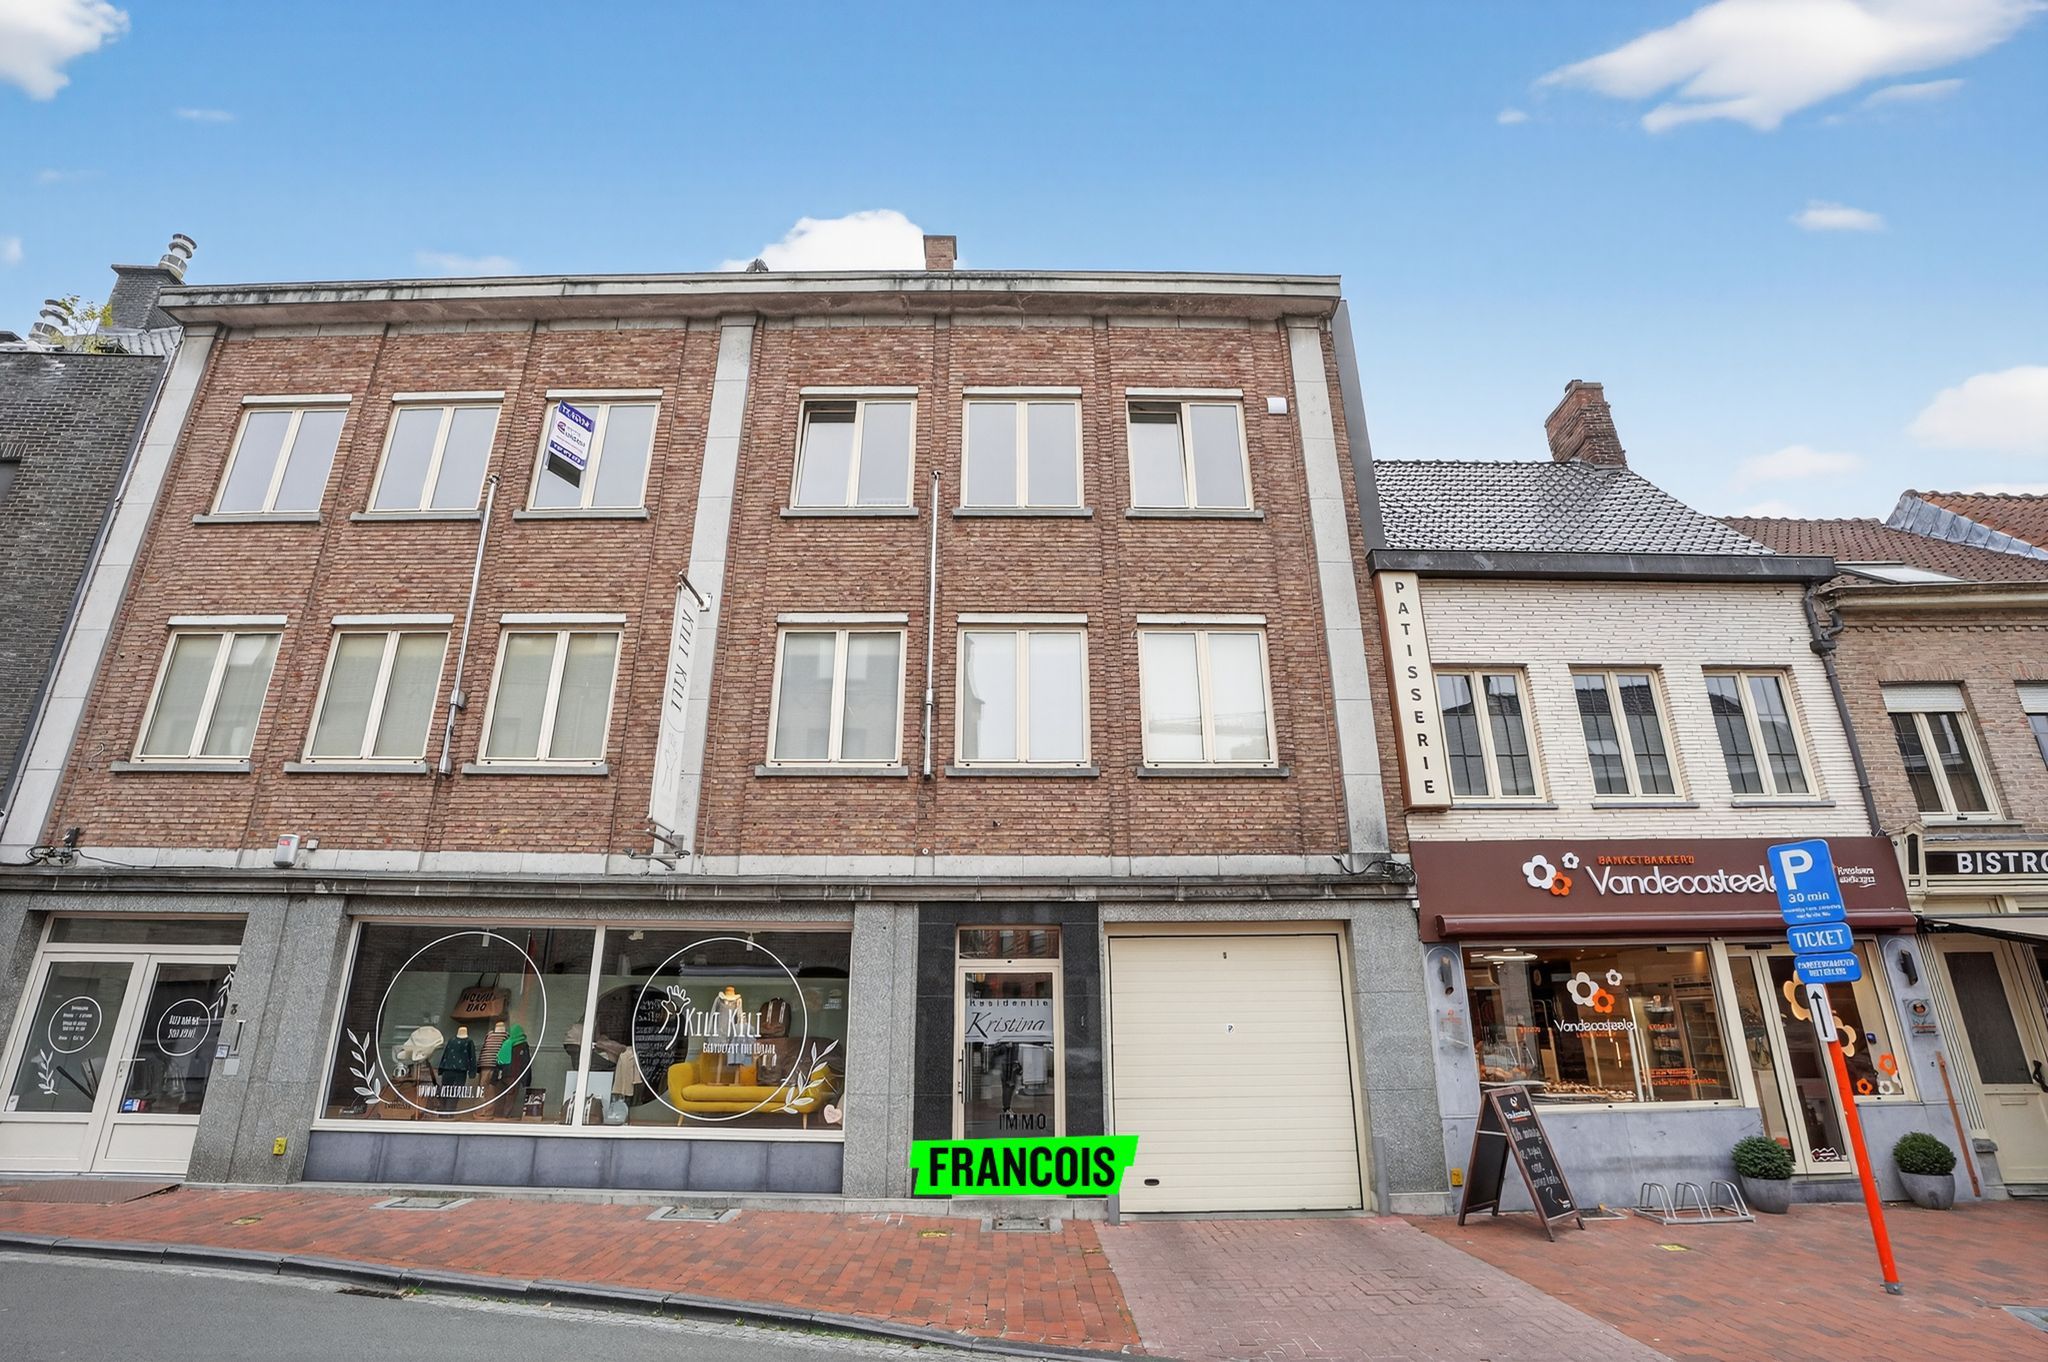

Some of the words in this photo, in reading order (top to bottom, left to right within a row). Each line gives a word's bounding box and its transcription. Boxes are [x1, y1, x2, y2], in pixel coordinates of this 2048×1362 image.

[1395, 581, 1435, 794] PATISSERIE
[1778, 848, 1814, 890] P
[1788, 893, 1805, 903] 30
[1808, 891, 1830, 902] min
[1792, 929, 1845, 949] TICKET
[969, 999, 1049, 1007] Residentie
[965, 1012, 1046, 1039] Kristina
